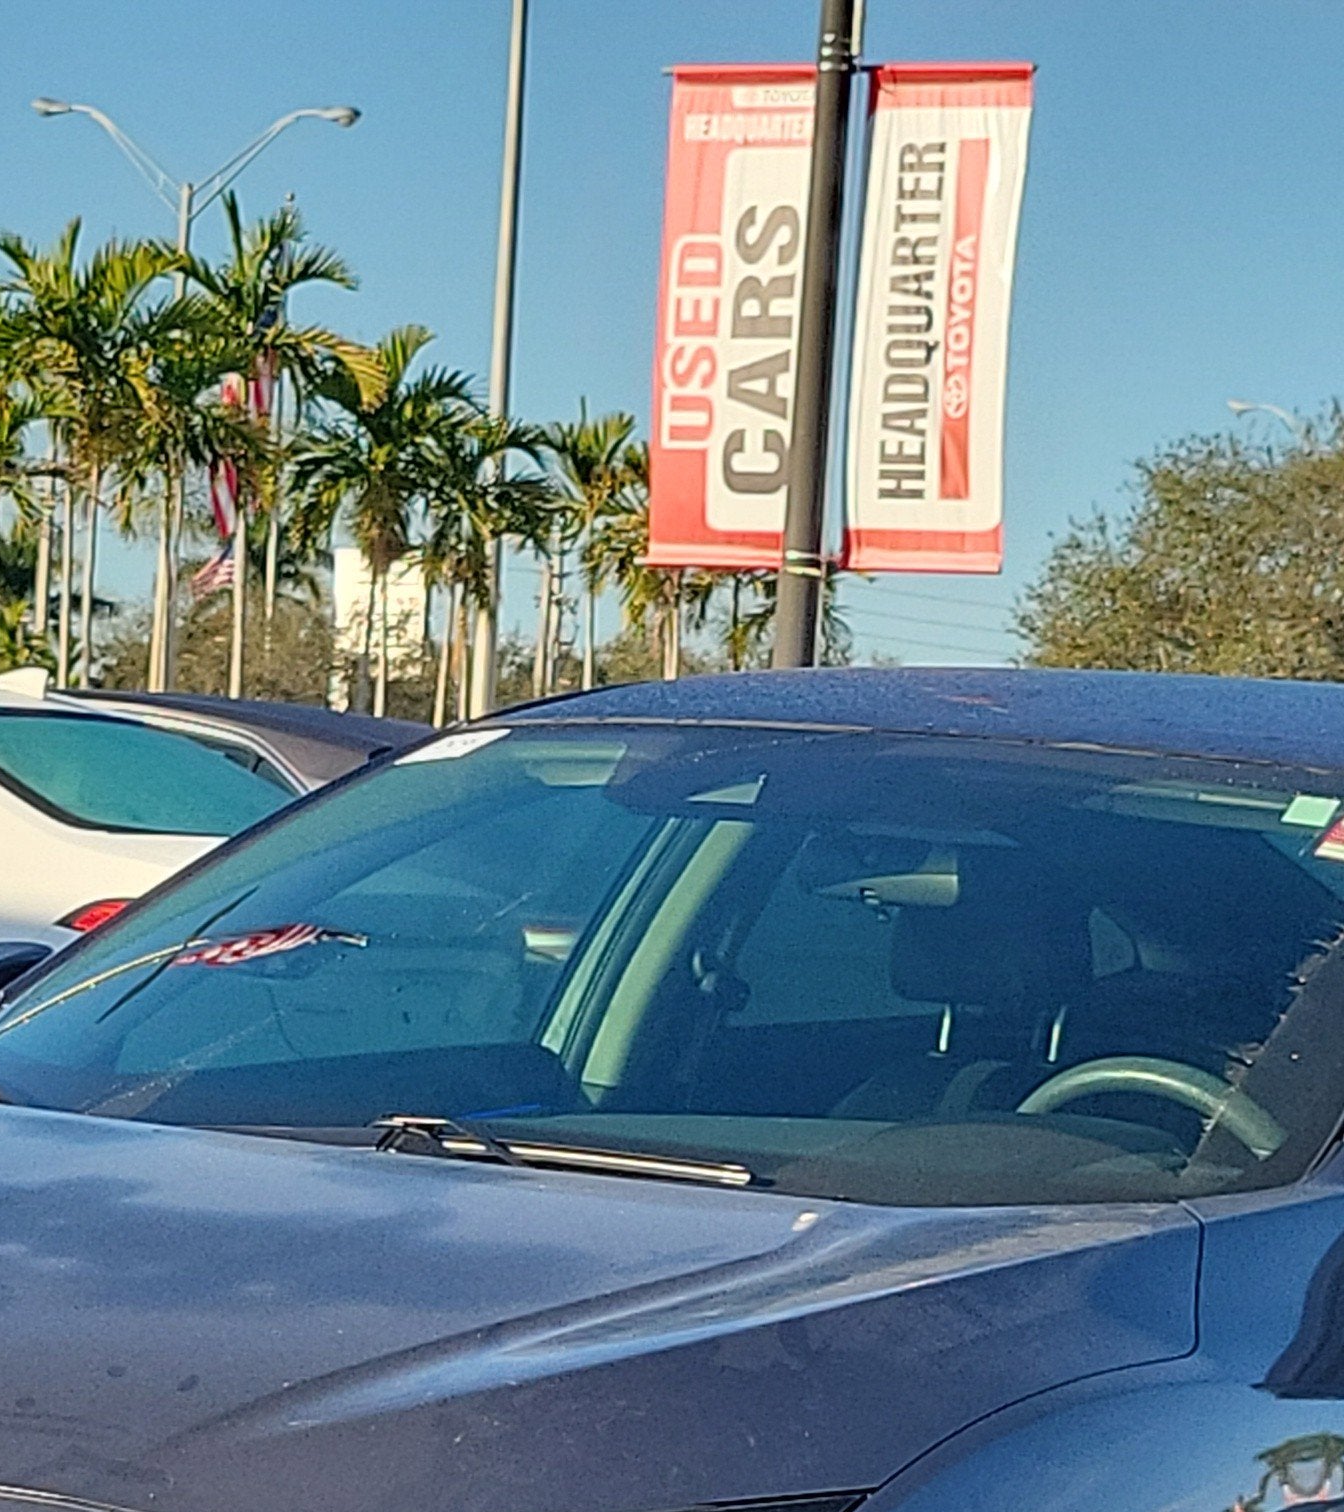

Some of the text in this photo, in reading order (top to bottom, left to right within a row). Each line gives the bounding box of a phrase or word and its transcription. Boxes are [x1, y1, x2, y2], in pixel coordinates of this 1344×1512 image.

[669, 242, 724, 442] USED
[723, 204, 800, 494] CARS
[877, 141, 947, 500] HEADQUARTER
[945, 236, 978, 371] TOYOTA
